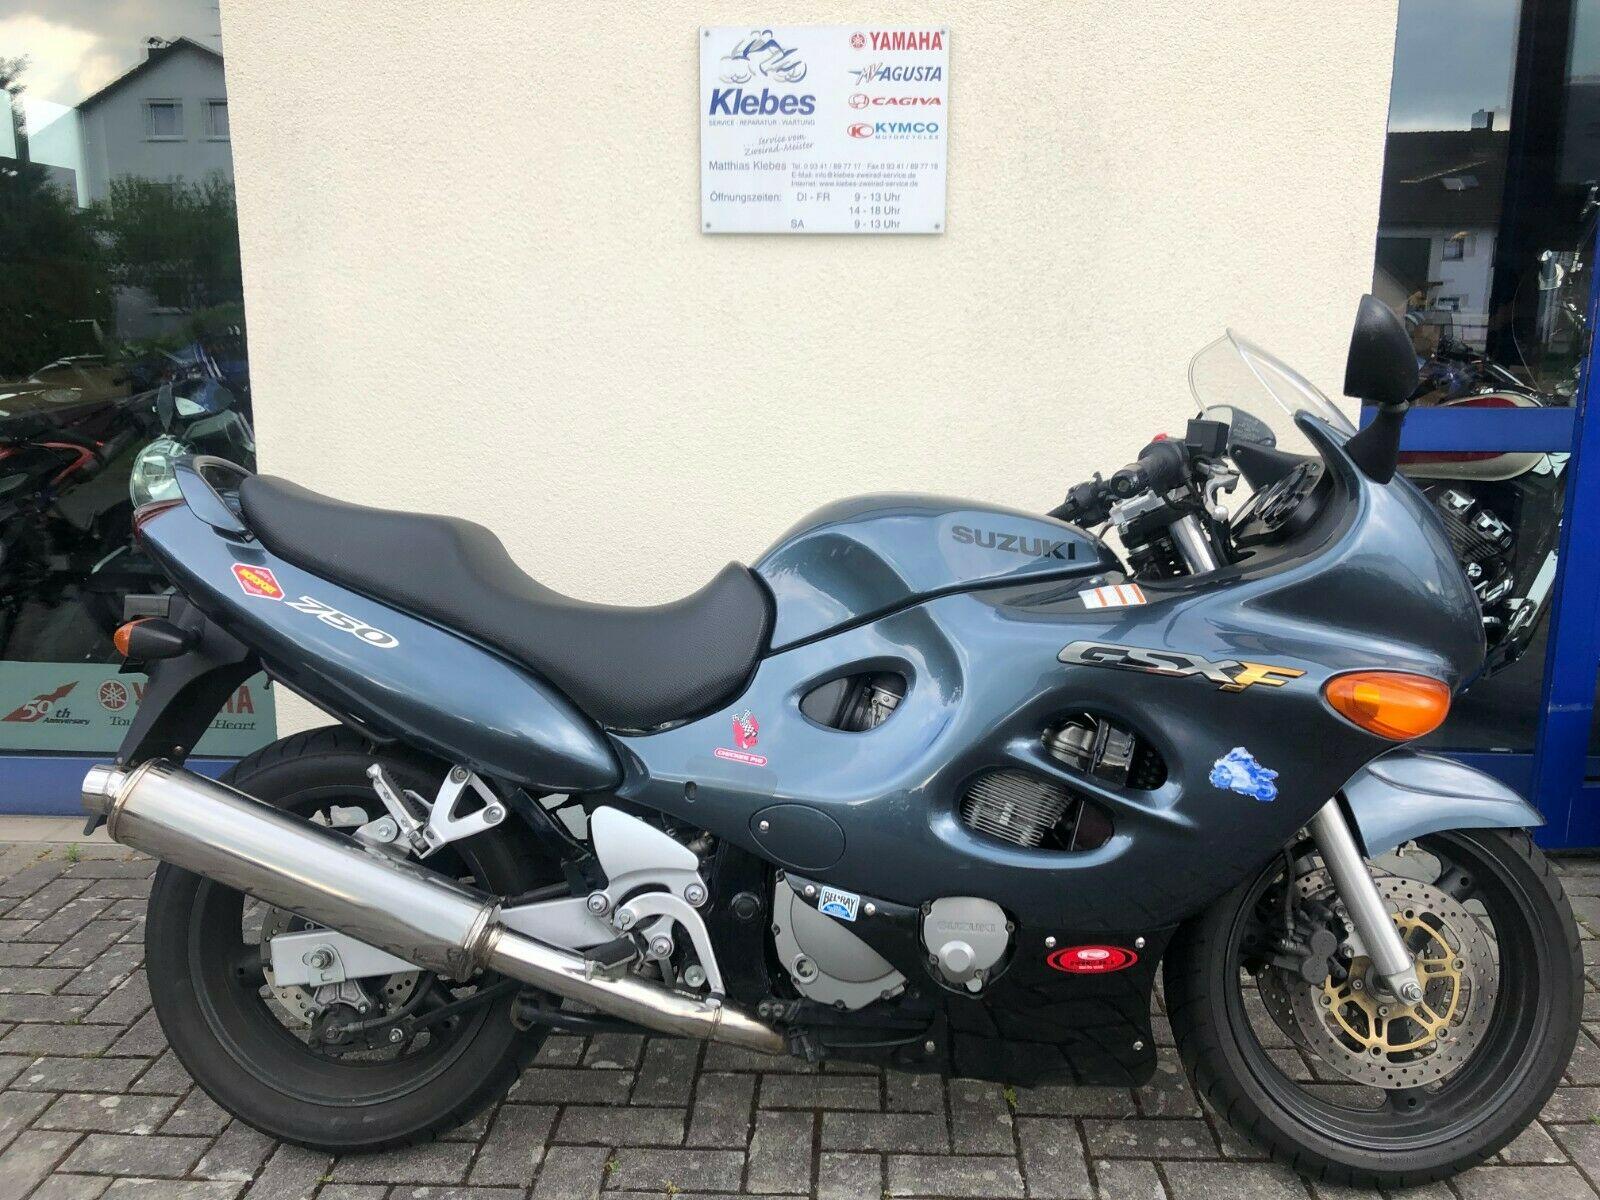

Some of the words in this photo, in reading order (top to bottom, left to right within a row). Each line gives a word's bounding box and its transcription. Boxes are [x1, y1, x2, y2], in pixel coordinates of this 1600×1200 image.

[869, 31, 943, 51] YAMAHA
[878, 66, 942, 82] AGUSTA
[709, 88, 817, 116] Klebes
[872, 97, 942, 106] CAGIVA
[875, 122, 939, 133] KYMCO
[709, 160, 750, 171] Matthias
[753, 160, 787, 171] Klebes
[709, 190, 782, 204] Öffnungszeiten:
[797, 192, 808, 202] DI
[816, 192, 831, 202] FR
[854, 192, 861, 202] 9
[870, 192, 882, 202] 13
[884, 192, 901, 202] Uhr
[849, 206, 860, 215] 14
[870, 206, 881, 215] 18
[883, 206, 900, 215] Uhr
[791, 219, 805, 229] SA
[854, 219, 861, 229] 9
[870, 219, 881, 229] 13
[883, 219, 901, 229] Uhr
[951, 525, 1077, 561] SUZUKI
[284, 595, 400, 649] 750
[42, 717, 91, 726] Anniversary
[214, 718, 256, 730] Heart
